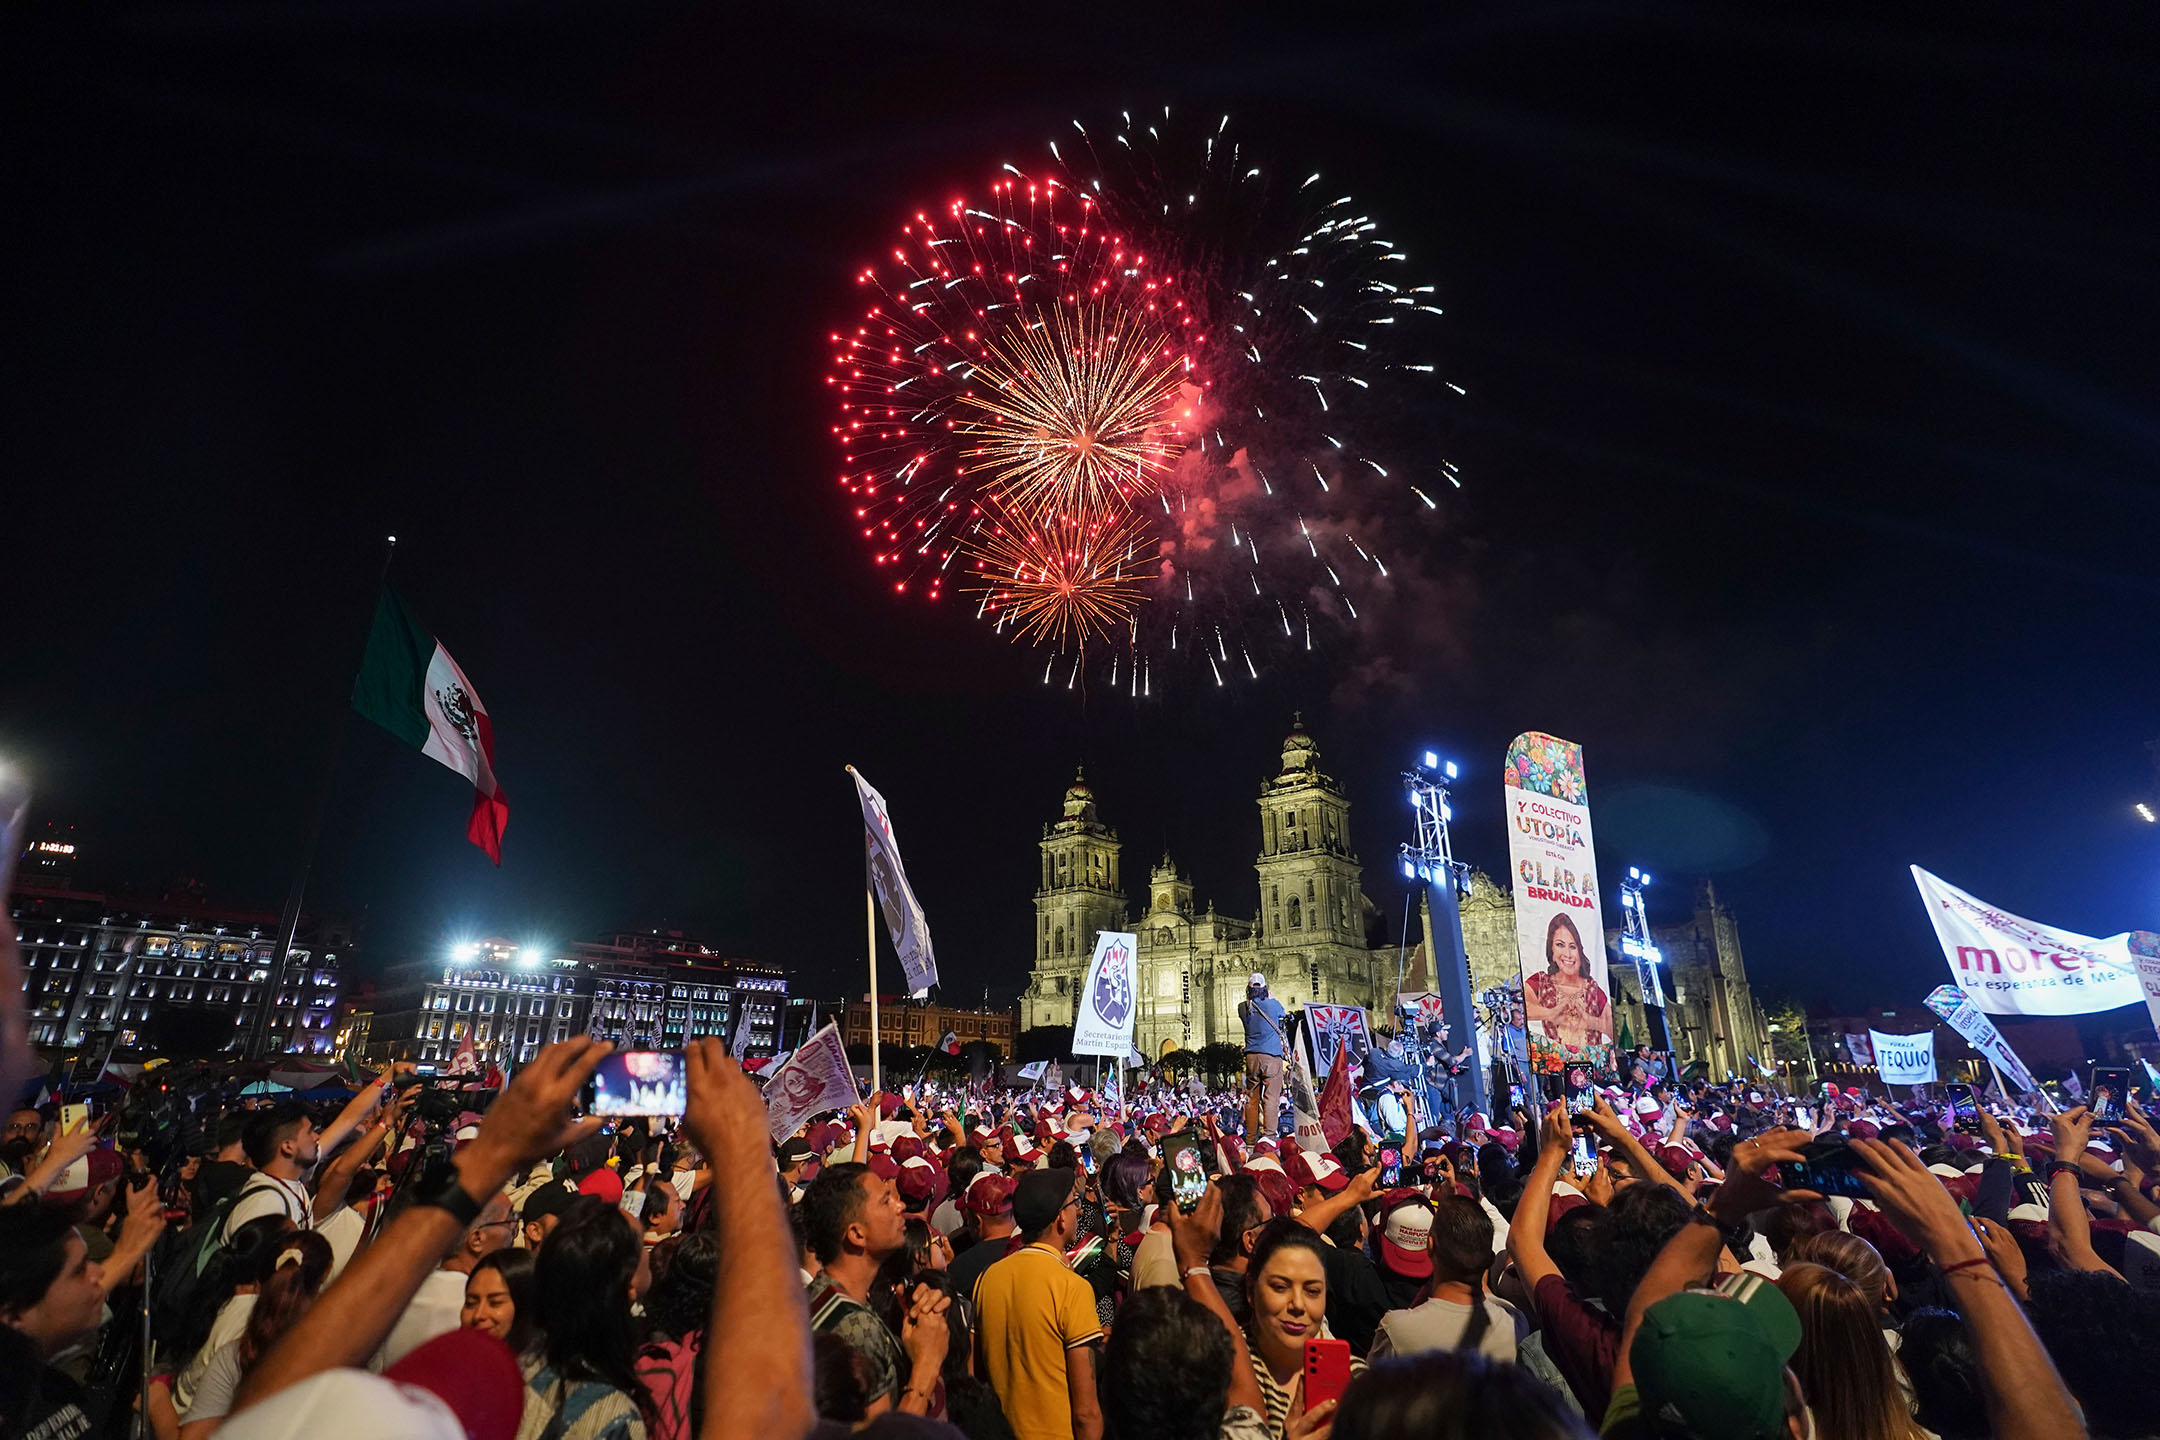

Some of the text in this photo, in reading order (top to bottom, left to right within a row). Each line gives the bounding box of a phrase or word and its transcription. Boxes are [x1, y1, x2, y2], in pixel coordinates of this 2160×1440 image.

[1531, 803, 1581, 825] COLECTIVO
[1515, 815, 1586, 848] UTOPÍA
[1519, 859, 1595, 897] CLARA
[1527, 886, 1595, 910] BRUGADA
[2062, 974, 2084, 986] de
[1075, 1038, 1104, 1049] Martín
[1879, 1049, 1930, 1071] TEQUIO
